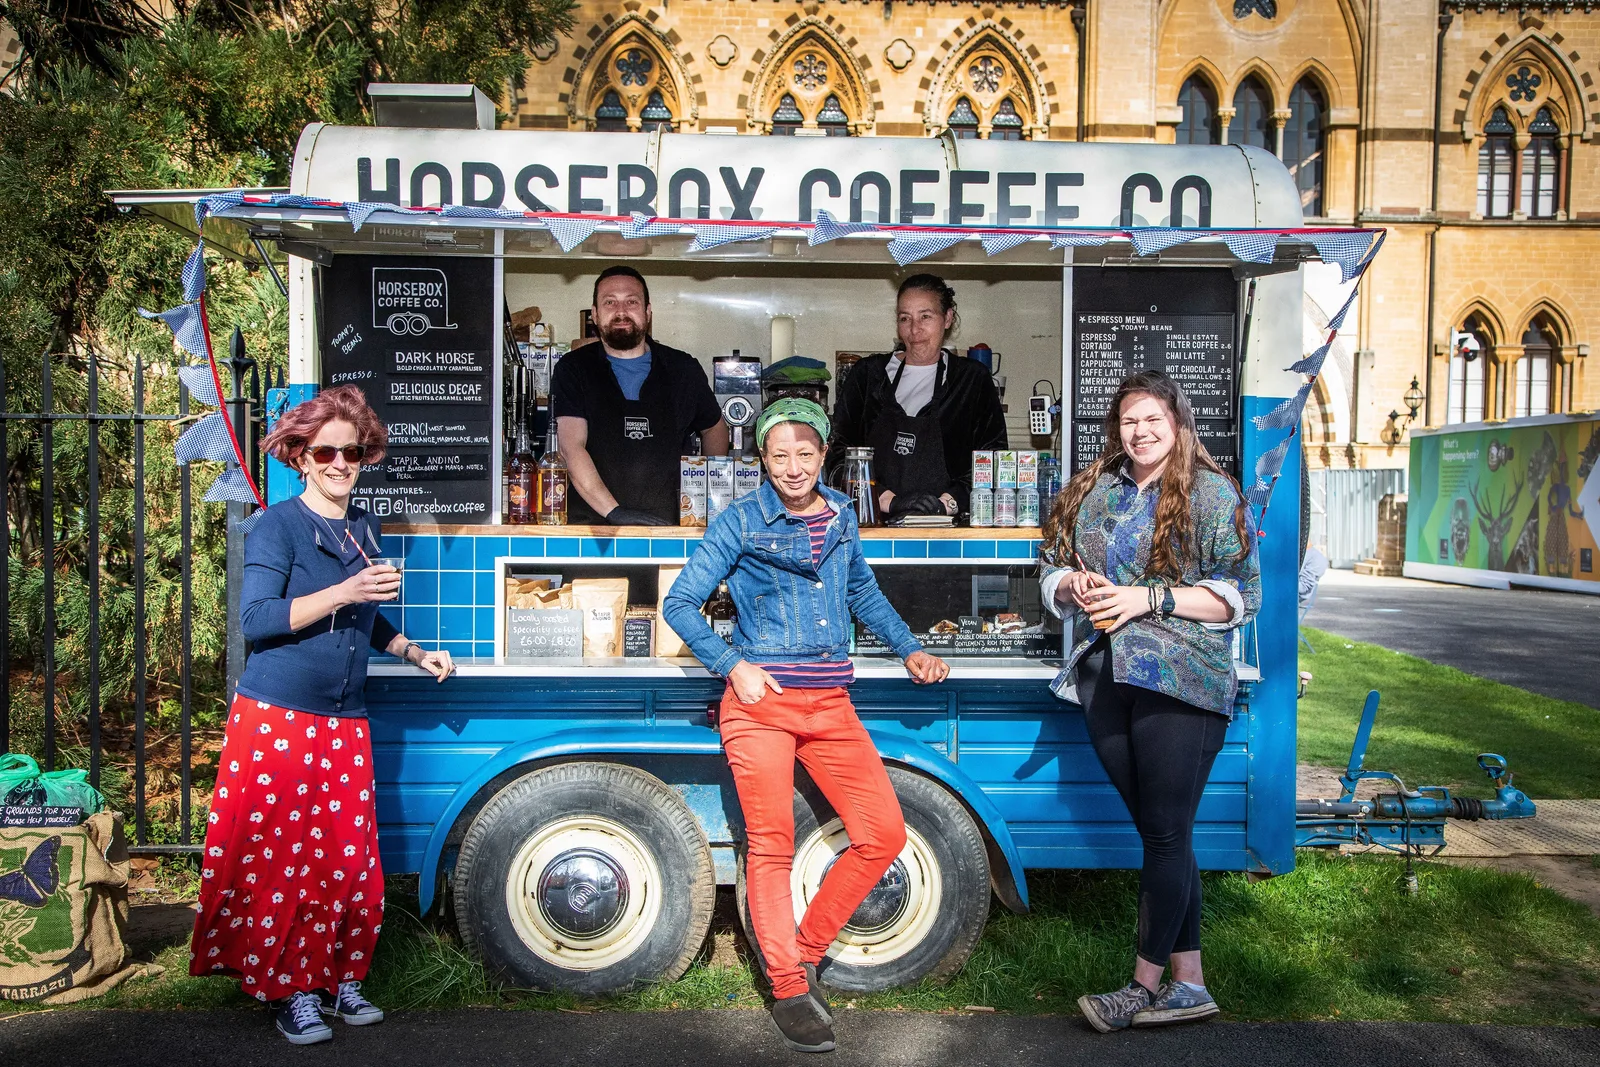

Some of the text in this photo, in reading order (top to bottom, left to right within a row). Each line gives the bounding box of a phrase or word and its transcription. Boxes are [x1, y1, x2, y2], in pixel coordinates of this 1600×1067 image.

[357, 157, 1212, 228] HORSEBOX COFFEE CO
[378, 281, 443, 297] HORSEBOX
[378, 297, 443, 308] COFFEE CO.
[1087, 316, 1145, 324] ESPRESSO MENU
[331, 323, 354, 348] TODAY'S
[1081, 333, 1117, 341] ESPRESSO
[341, 332, 363, 355] BEANS
[1080, 342, 1112, 350] CORTADO
[1166, 341, 1190, 349] FILTER
[1192, 341, 1219, 349] COFFEE
[395, 351, 475, 365] DARK HORSE
[552, 352, 563, 360] alp
[1080, 351, 1098, 359] FLAT
[1100, 351, 1122, 359] WHITE
[1165, 352, 1182, 360] CHAI
[1183, 352, 1205, 360] LATTE
[1080, 360, 1123, 368] CAPPUCCINO
[1080, 369, 1103, 377] CAFFE
[1104, 369, 1126, 377] LATTE
[1165, 365, 1179, 373] HOT
[1181, 365, 1216, 373] CHOCOLAT
[391, 383, 482, 395] DELICIOUS DECAF
[1080, 386, 1103, 394] CAFFE
[1199, 408, 1220, 416] MILK
[387, 422, 428, 436] KERINCI
[1078, 424, 1101, 432] ON ICE
[1078, 435, 1096, 444] COLD
[1078, 444, 1100, 452] CAFFE
[1443, 439, 1459, 449] What's
[1078, 453, 1094, 461] CHAI
[1442, 449, 1480, 462] happening here?
[392, 455, 460, 466] TAPIR ANDINO
[386, 465, 406, 473] SWEET
[682, 467, 706, 479] alpro
[736, 467, 759, 479] alpro
[374, 487, 432, 495] ADVENTURES...
[512, 612, 541, 626] Locally
[960, 619, 978, 627] VEGAN
[513, 625, 580, 636] speciality coffee
[5, 806, 42, 815] GROUNDS
[44, 807, 58, 815] FOR
[61, 807, 80, 816] YOUR
[27, 816, 43, 825] HELP
